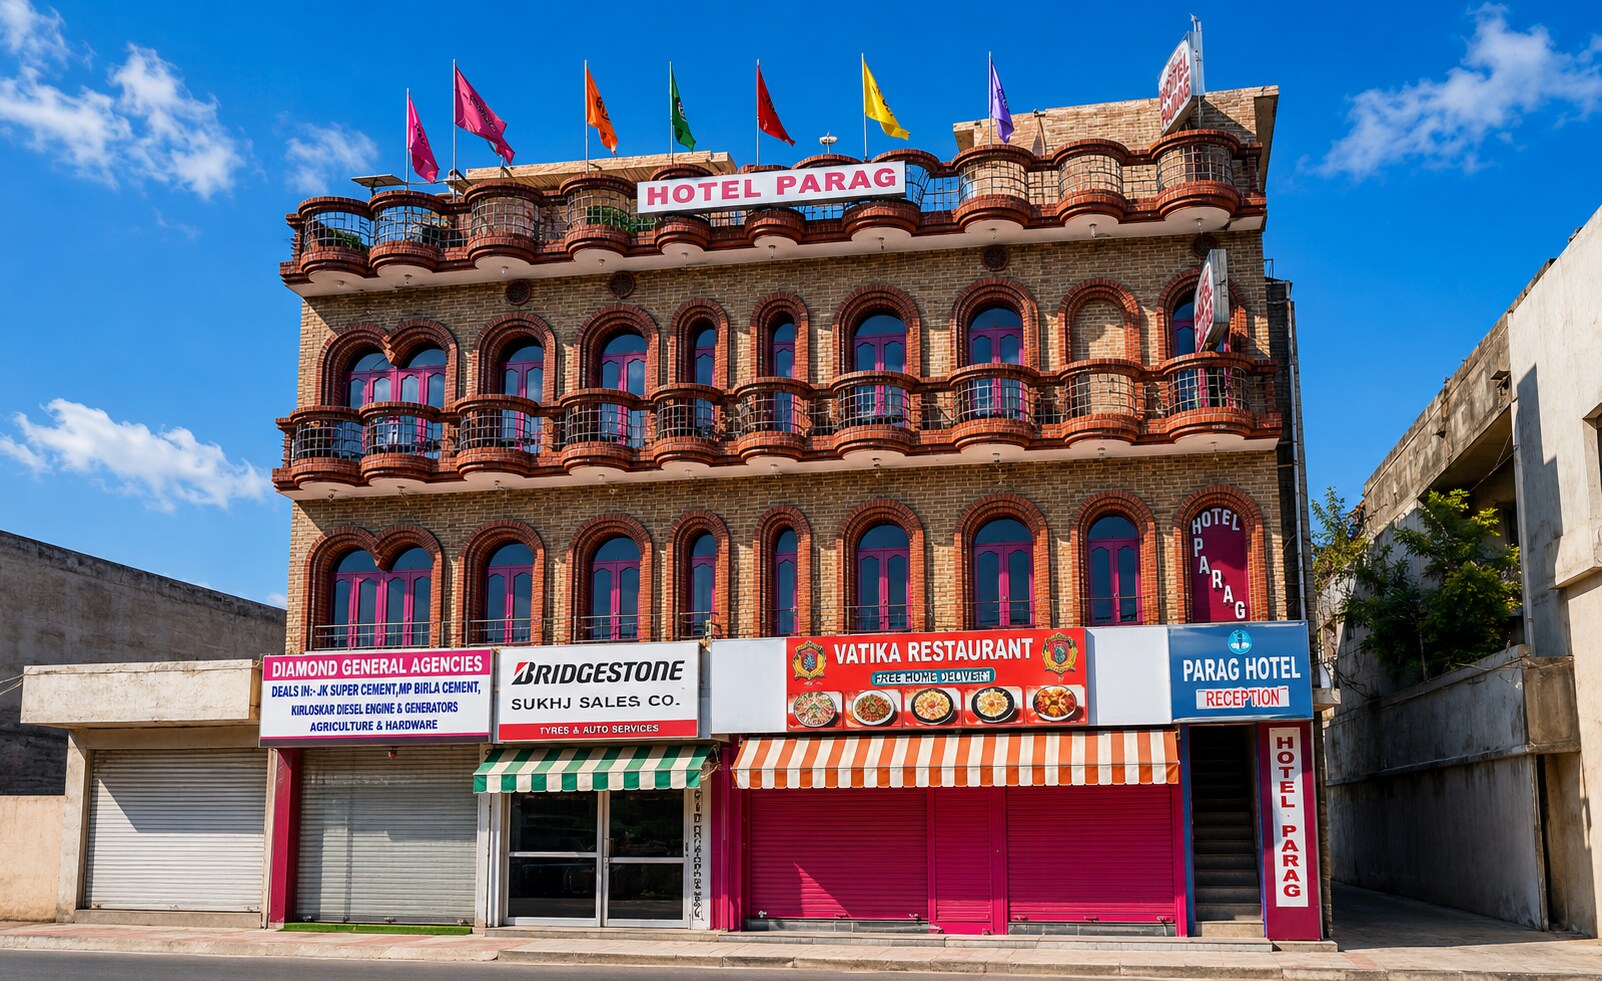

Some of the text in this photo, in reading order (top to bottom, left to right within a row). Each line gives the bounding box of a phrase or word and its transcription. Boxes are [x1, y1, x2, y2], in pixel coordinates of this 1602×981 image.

[647, 167, 896, 206] HOTEL PARAG
[1192, 508, 1240, 535] HOTEL
[1193, 537, 1246, 619] PARAG
[833, 637, 1034, 665] VATIKA RESTAURANT
[272, 655, 483, 678] DIAMOND GENERAL AGENCIES
[511, 659, 686, 685] BRIDGESTONE
[1183, 656, 1301, 682] PARAG HOTEL
[271, 685, 299, 698] DEALS
[300, 685, 316, 697] IN:-
[317, 684, 329, 697] JK
[330, 684, 359, 696] SUPER
[414, 681, 440, 695] BIRLA
[442, 681, 481, 695] CEMENT,
[1206, 688, 1280, 707] RECEPTION
[291, 701, 459, 716] KIRLOSKAR DIESEL ENGINE & GENERATORS
[511, 694, 681, 711] SUKHJ SALES CO.
[310, 719, 438, 732] AGRICULTURE & HARDWARE
[539, 723, 659, 735] TYRES & AUTO SERVICES
[1276, 736, 1301, 898] HOTEL PARAG
